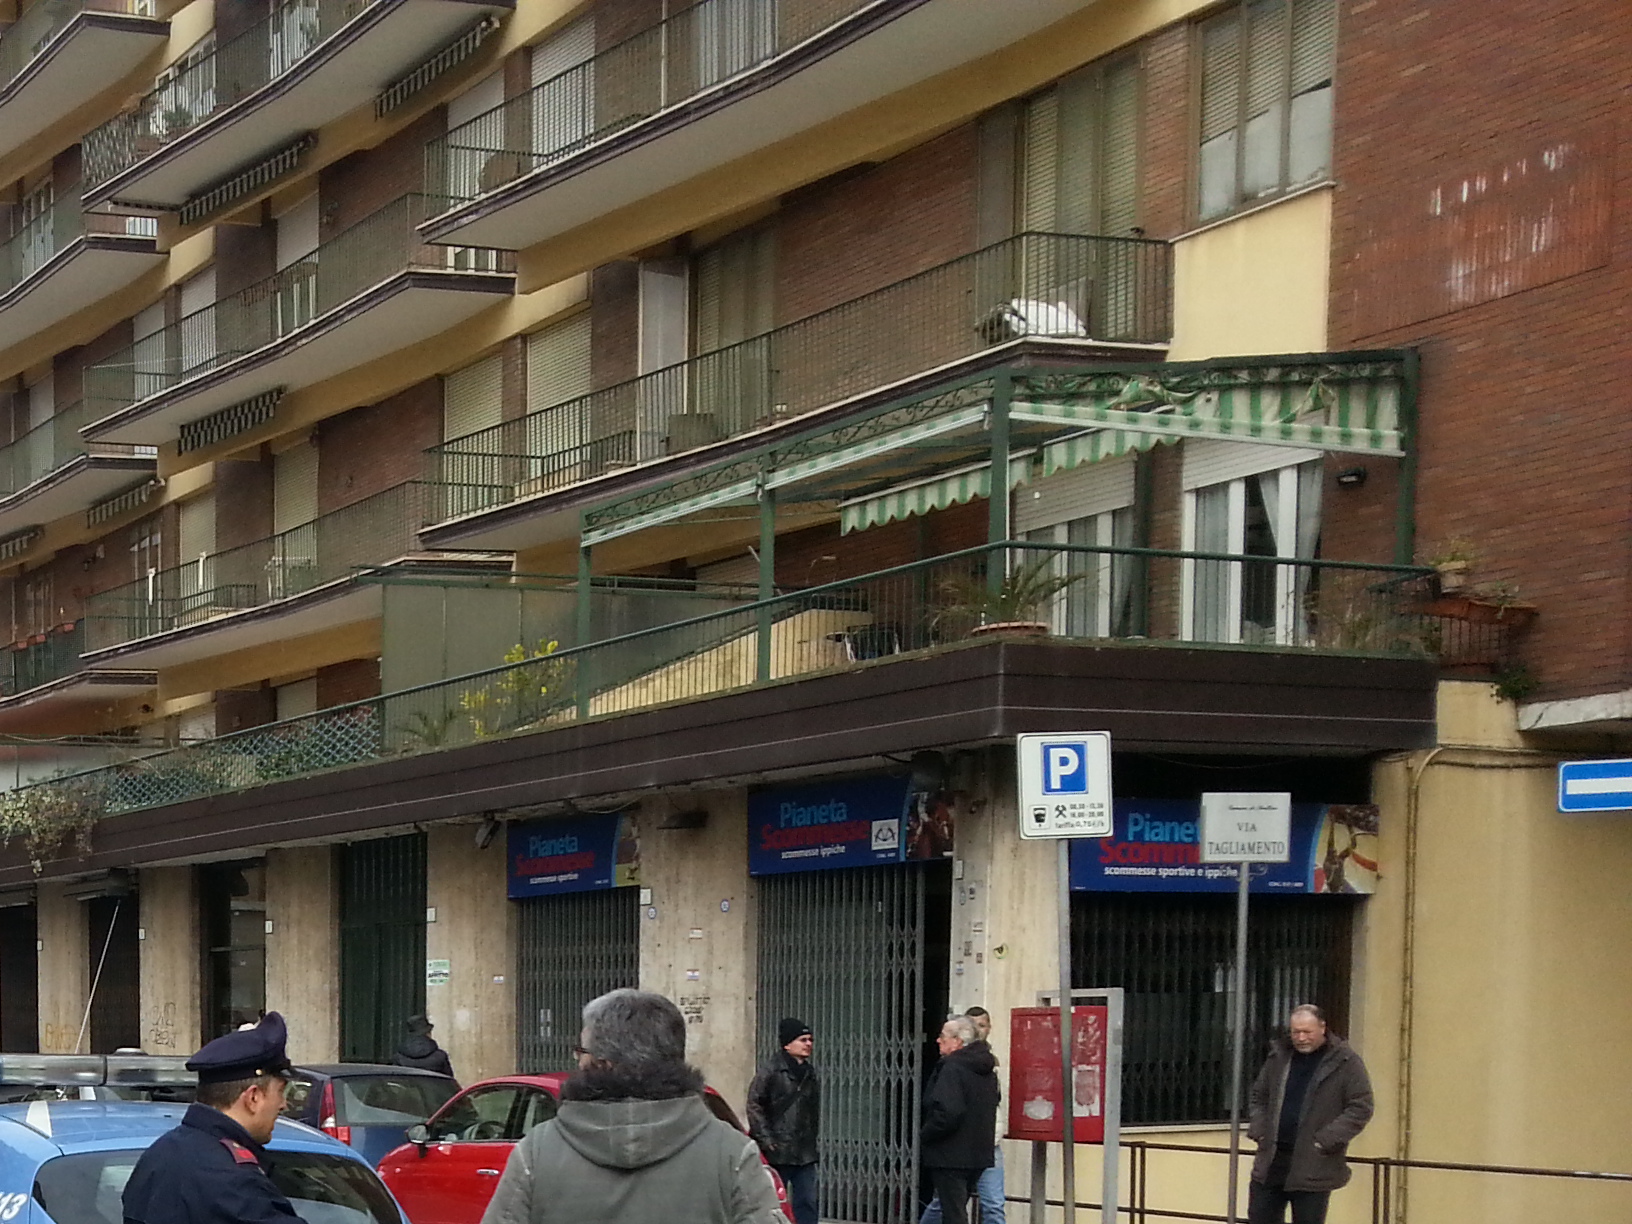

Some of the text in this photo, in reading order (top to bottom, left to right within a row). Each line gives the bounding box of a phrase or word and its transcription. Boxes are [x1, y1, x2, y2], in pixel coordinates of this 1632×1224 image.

[1049, 747, 1079, 789] P
[780, 800, 847, 828] Pianeta
[1237, 822, 1257, 832] VIA
[530, 834, 578, 858] Pianeta
[1208, 841, 1285, 855] TAGLIAMENTO
[1104, 867, 1157, 876] scommesse
[1158, 866, 1195, 878] sportive
[1205, 866, 1238, 879] ippiche
